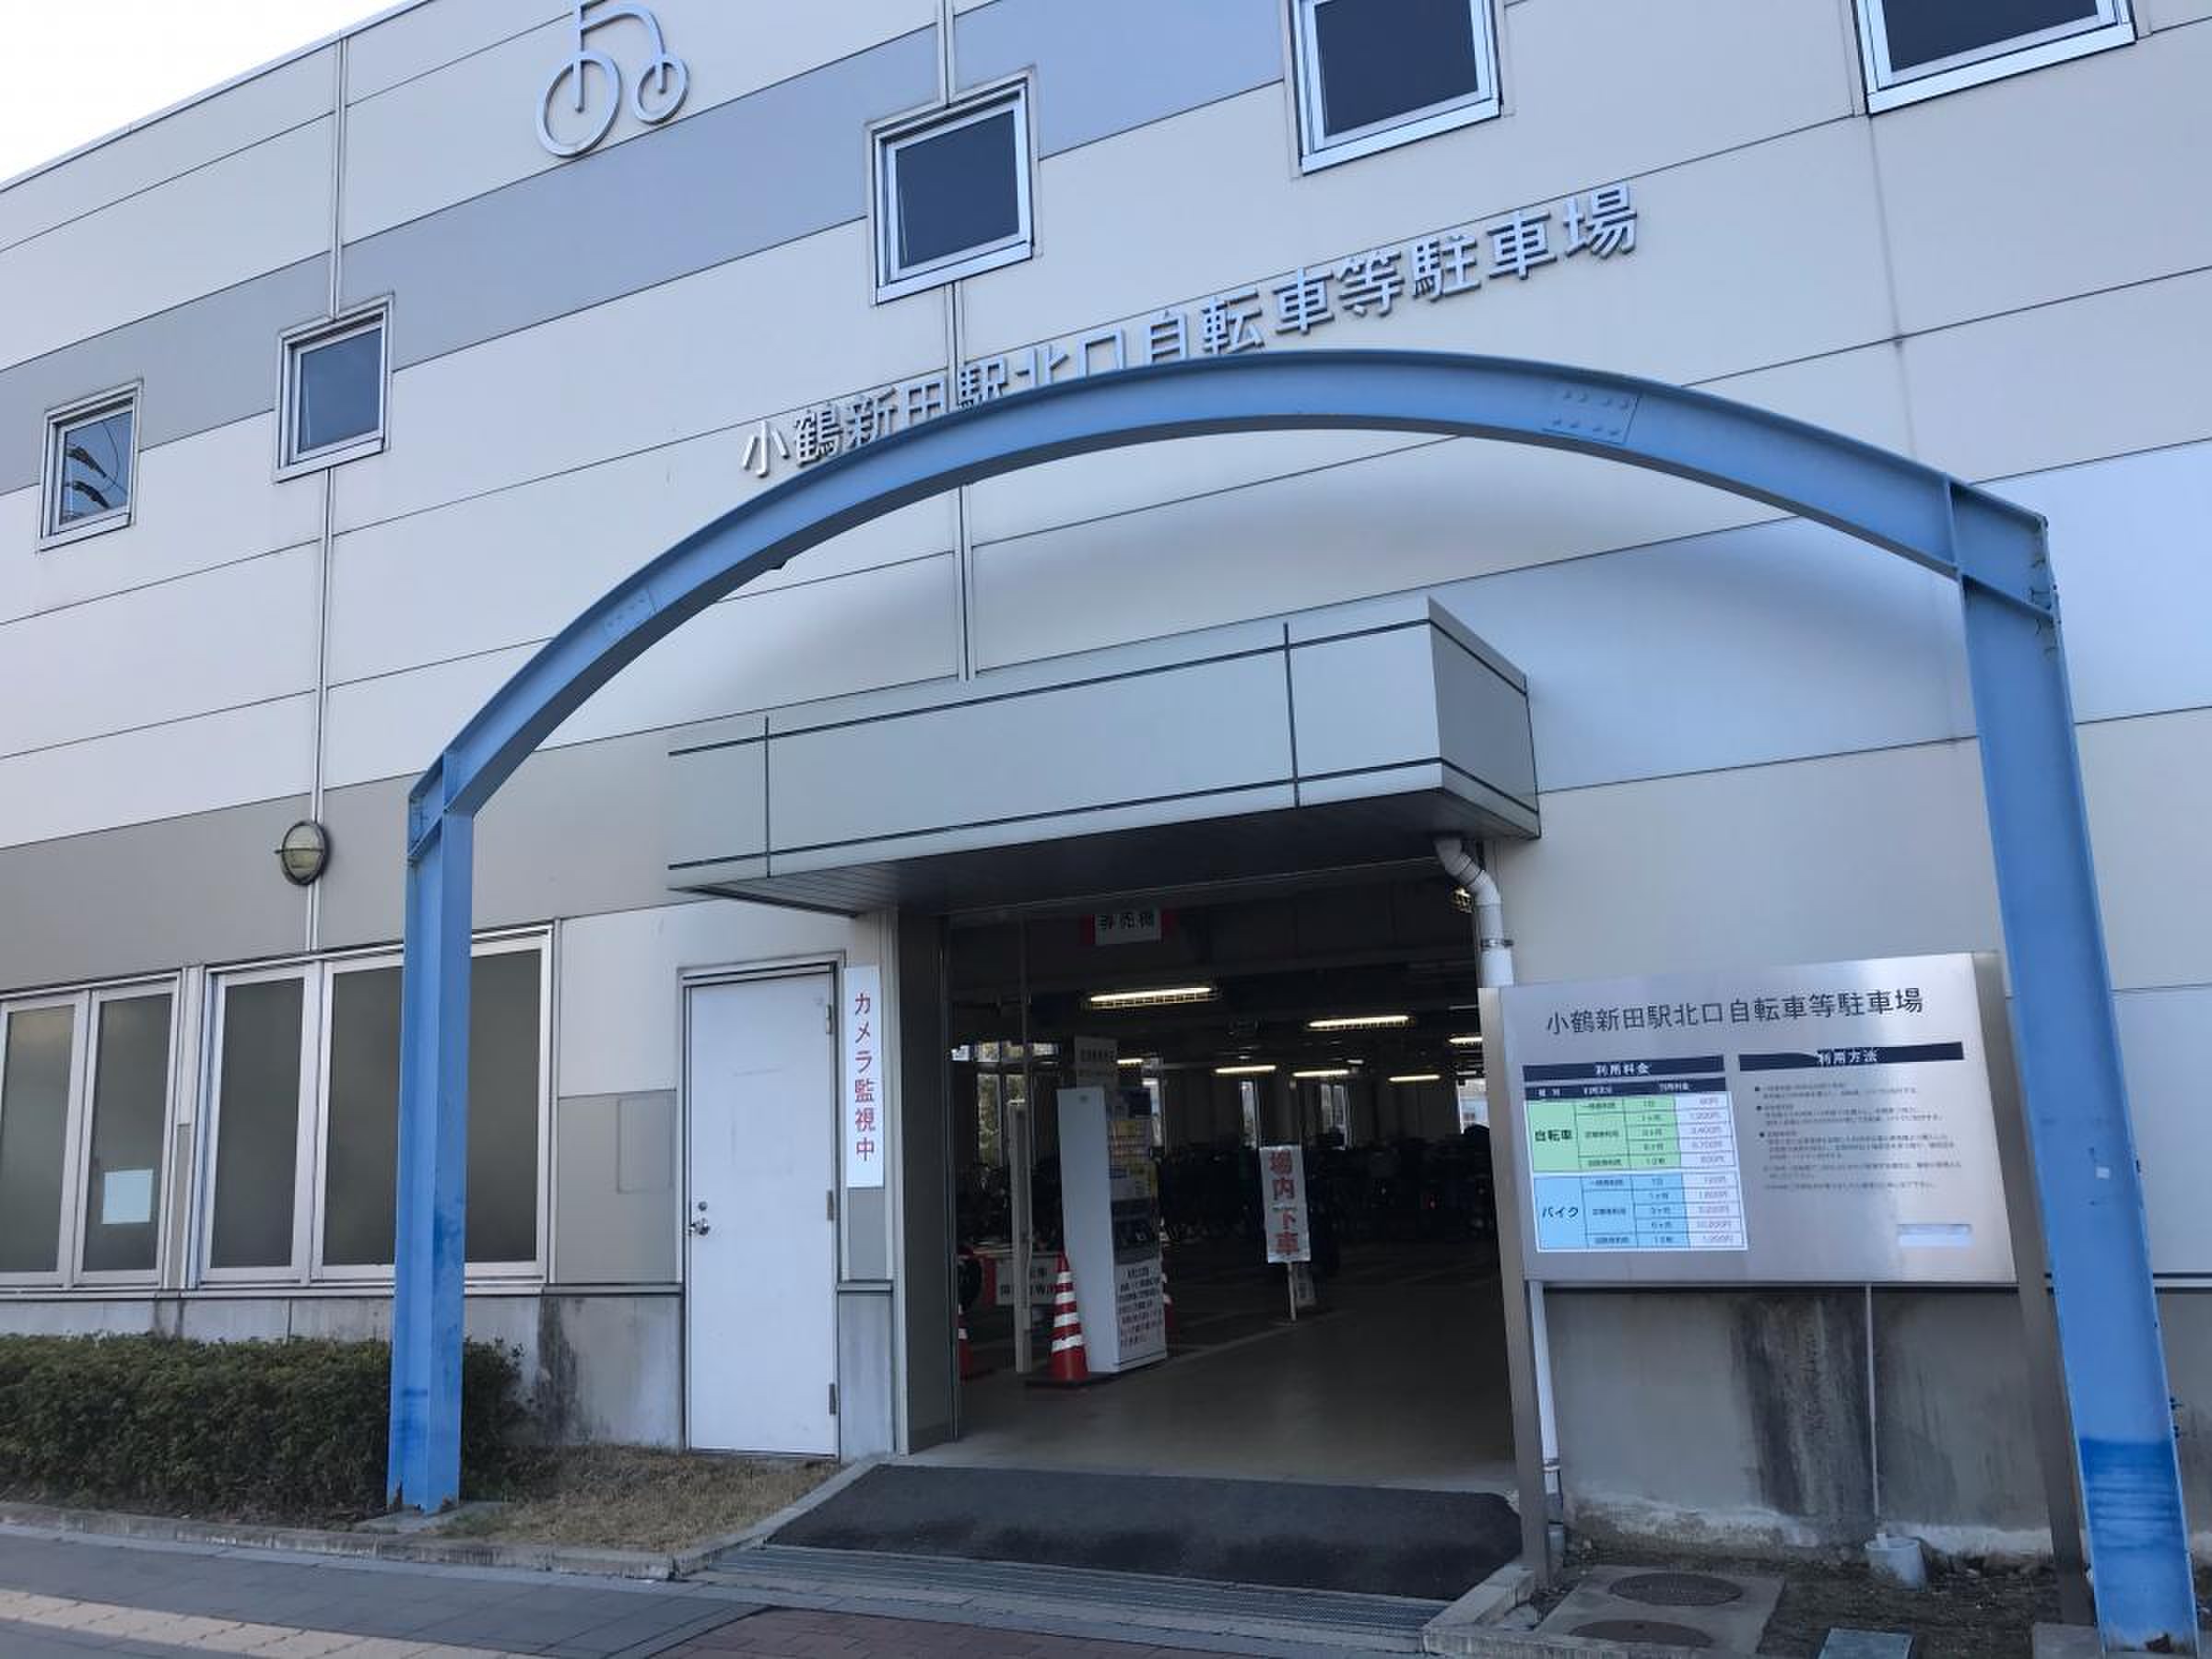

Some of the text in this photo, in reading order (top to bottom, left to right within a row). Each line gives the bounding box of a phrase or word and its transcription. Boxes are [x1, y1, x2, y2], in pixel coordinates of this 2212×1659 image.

[743, 182, 1640, 477] 小鶴新田駅北口自転車等駐車場
[1547, 987, 1924, 1035] 小鶴新田駅北口自転車等駐車場
[1818, 1049, 1877, 1065] 利用方法
[854, 993, 876, 1162] カメラ監視中
[1594, 1063, 1651, 1077] 利用料金
[1535, 1130, 1572, 1143] 自転車
[1542, 1206, 1579, 1219] バイク
